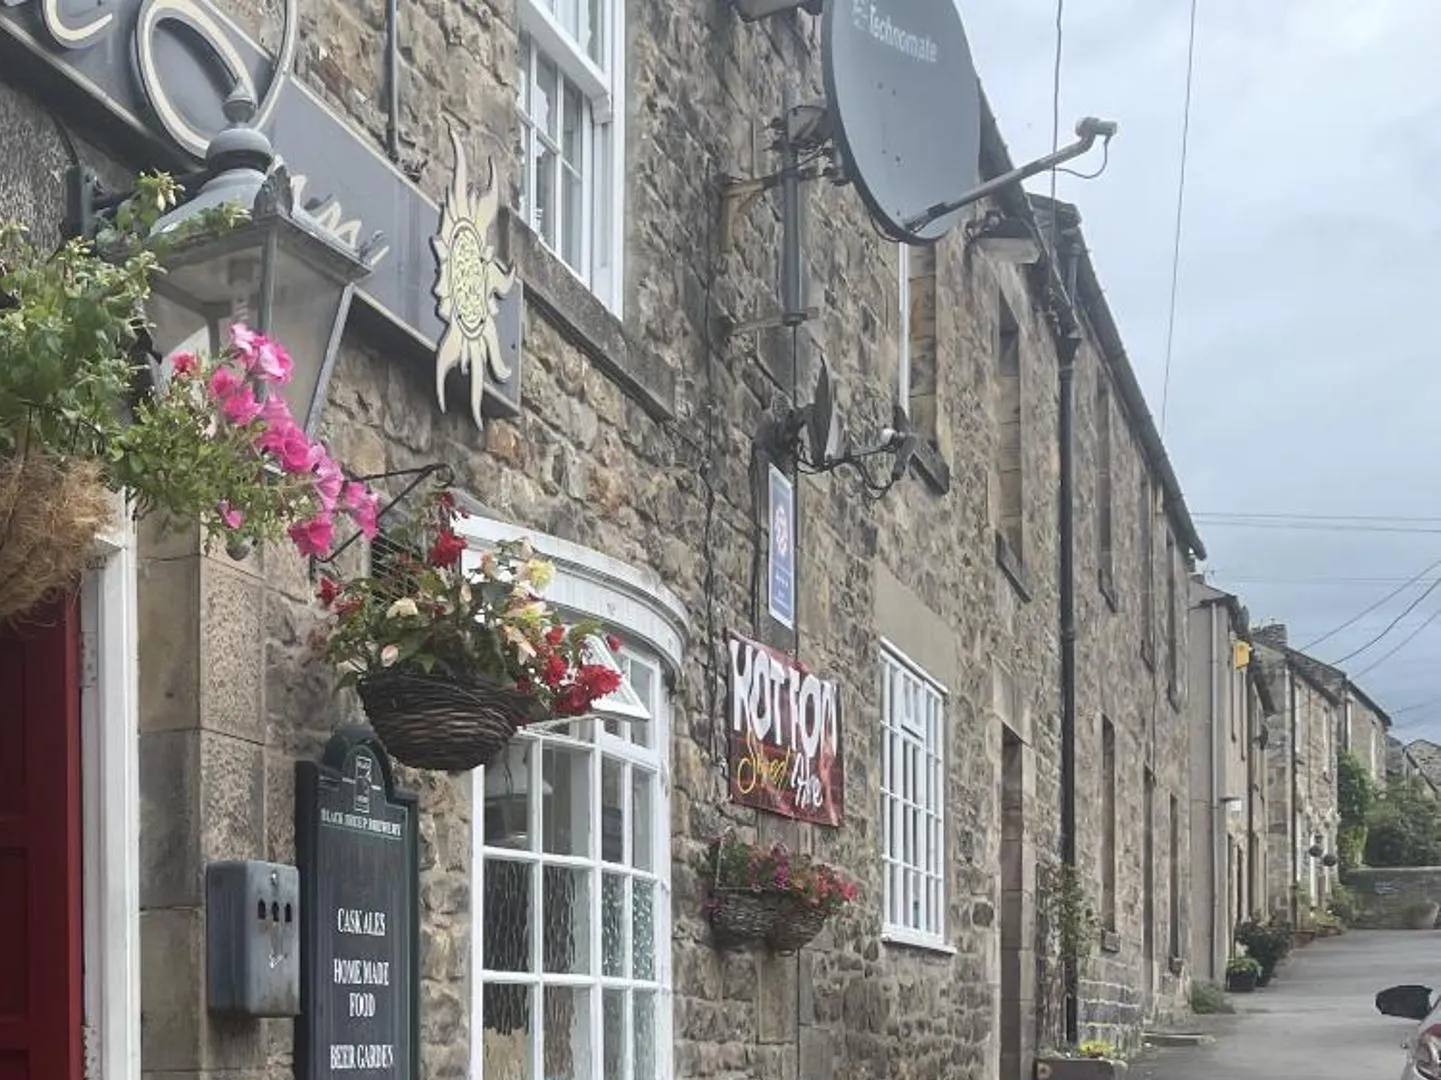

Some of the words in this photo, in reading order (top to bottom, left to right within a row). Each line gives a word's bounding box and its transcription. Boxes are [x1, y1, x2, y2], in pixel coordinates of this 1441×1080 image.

[337, 908, 362, 934] CASK
[363, 911, 385, 936] ALES
[349, 992, 376, 1017] FOOD
